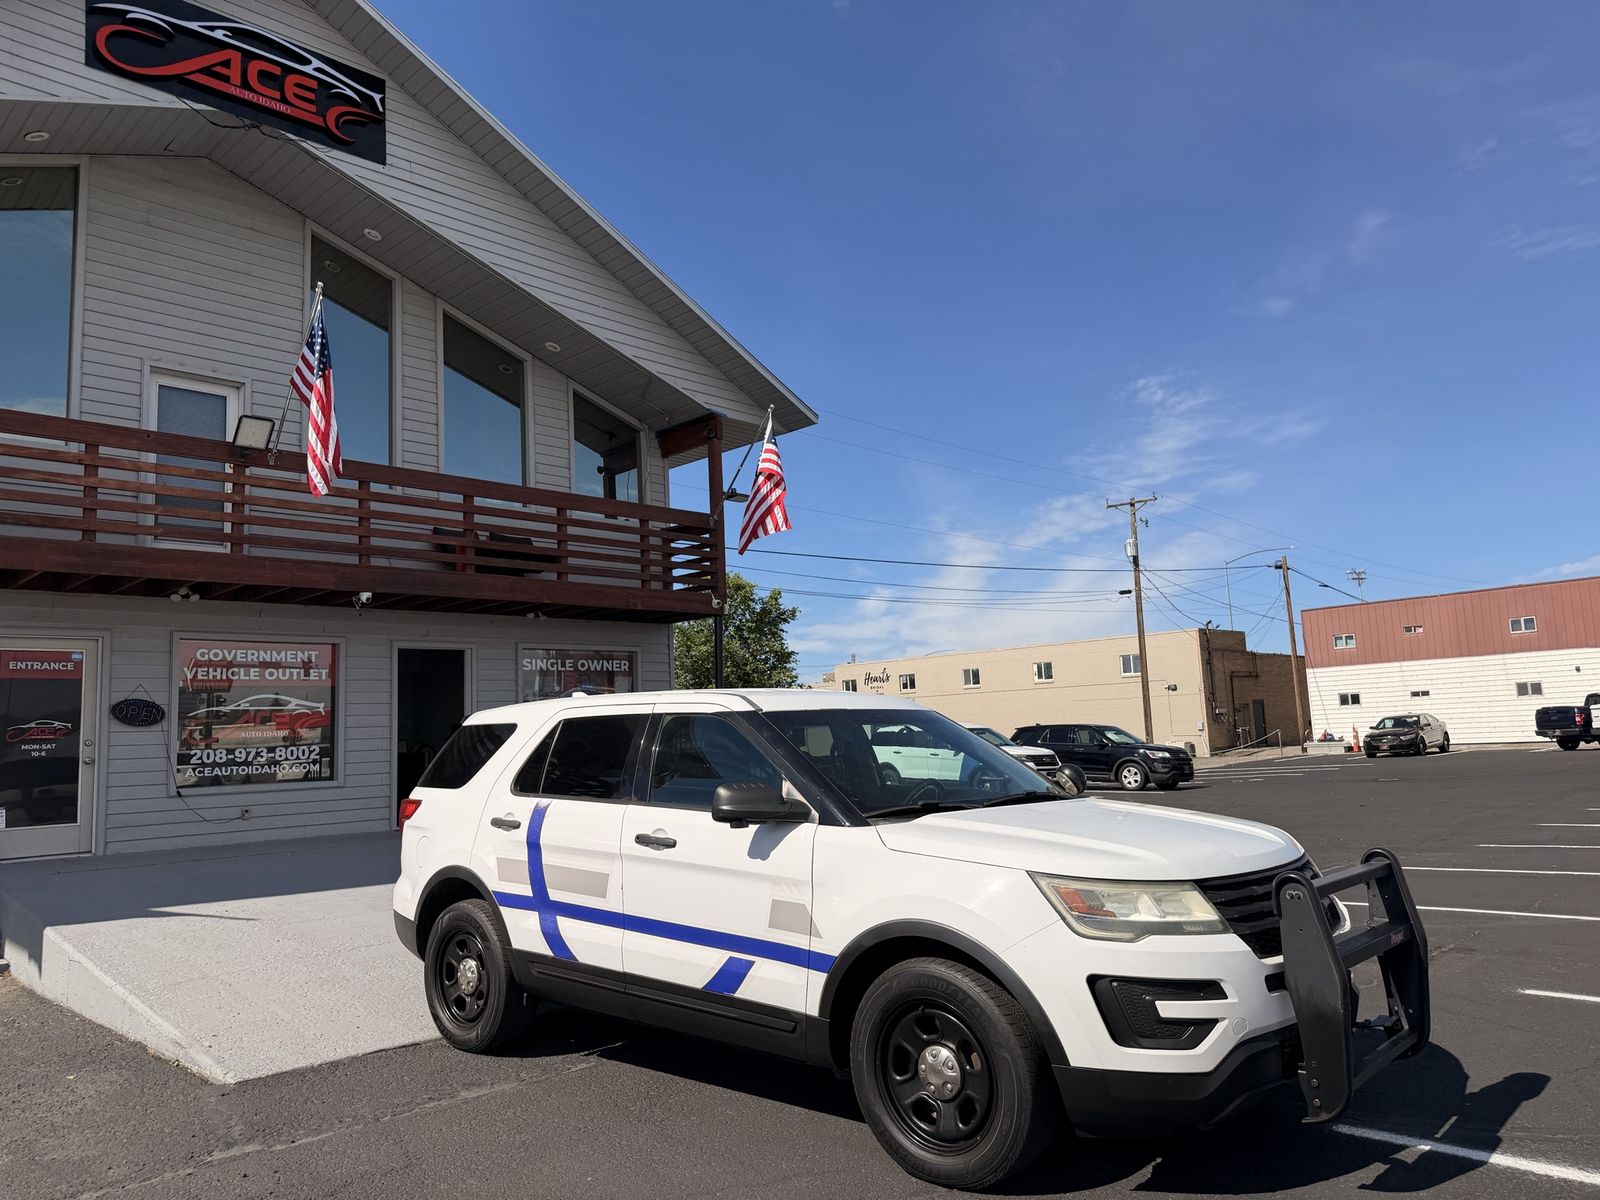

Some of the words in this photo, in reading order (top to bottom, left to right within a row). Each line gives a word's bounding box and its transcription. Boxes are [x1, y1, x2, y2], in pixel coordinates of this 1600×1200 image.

[229, 86, 257, 102] AUTO
[259, 96, 291, 113] IDAHO
[196, 648, 319, 663] GOVERNMENT
[9, 661, 75, 671] ENTRANCE
[522, 658, 575, 671] SINGLE
[577, 659, 630, 672] OWNER
[183, 667, 260, 681] VEHICLE
[264, 669, 329, 681] OUTLET
[115, 704, 163, 721] OPEN
[21, 743, 57, 751] MON-SAT
[190, 746, 320, 764] 208-973-8002
[185, 762, 320, 778] ACEAUTOIDAHO.COM
